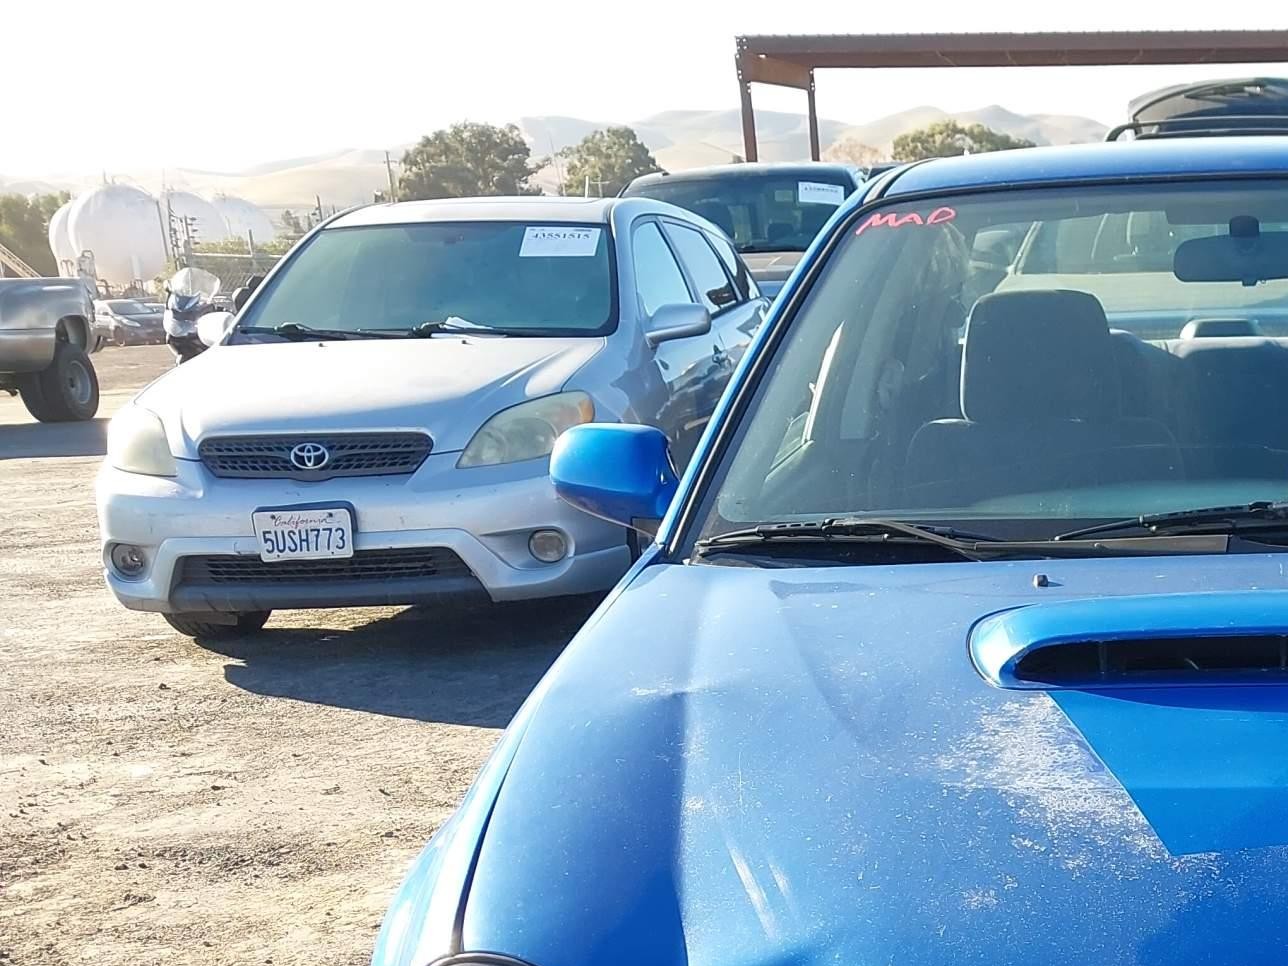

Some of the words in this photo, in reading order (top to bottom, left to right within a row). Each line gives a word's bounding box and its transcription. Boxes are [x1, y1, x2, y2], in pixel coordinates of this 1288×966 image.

[855, 206, 957, 236] MAD
[273, 513, 335, 529] California
[262, 527, 346, 554] 5USH773
